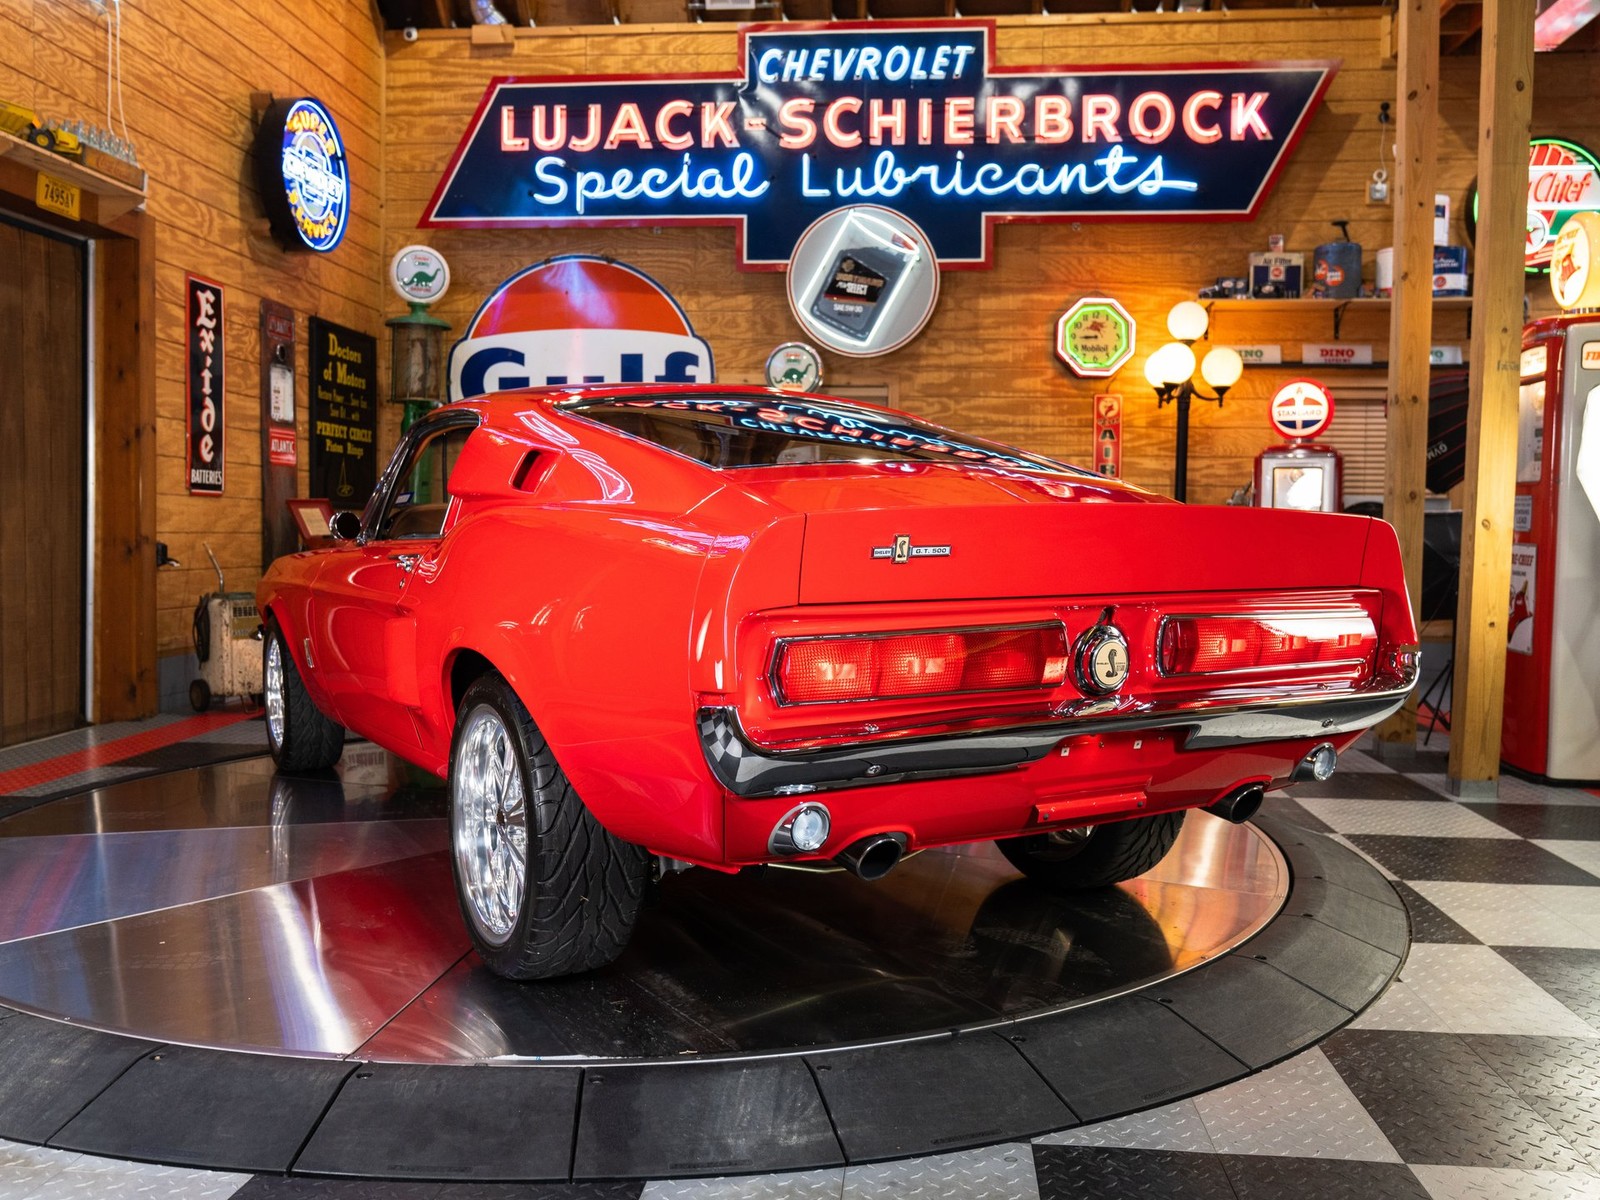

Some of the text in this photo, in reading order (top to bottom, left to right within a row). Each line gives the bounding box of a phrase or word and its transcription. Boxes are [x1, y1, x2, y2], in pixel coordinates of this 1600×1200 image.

[758, 46, 975, 82] CHEVROLET
[532, 144, 1198, 215] Special Lubricants
[1534, 172, 1593, 203] Chief
[328, 332, 362, 364] Doctors
[1240, 349, 1264, 358] INO
[1319, 348, 1355, 358] DINO
[196, 289, 217, 463] Exide
[323, 361, 367, 390] of Motors
[461, 346, 699, 400] Glf
[271, 438, 295, 455] ATLANTIC
[316, 421, 373, 443] PERFECT CIRCLE
[325, 439, 364, 460] Piston Rings
[1099, 428, 1116, 475] AIR
[191, 468, 222, 485] BATTERIES
